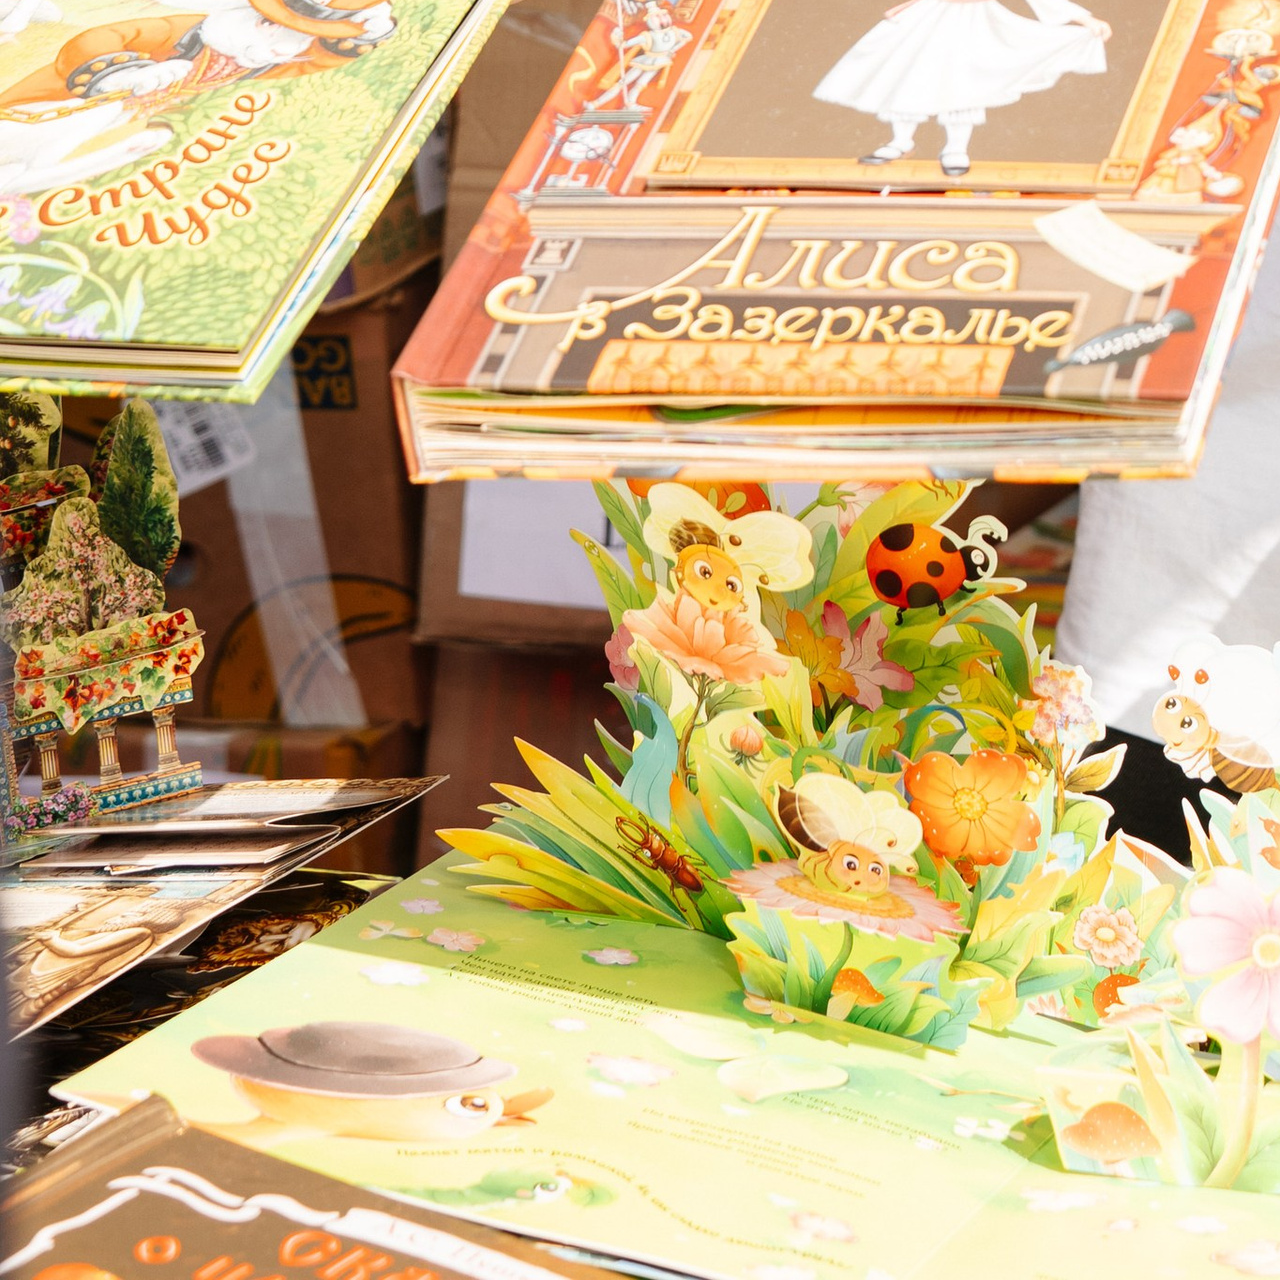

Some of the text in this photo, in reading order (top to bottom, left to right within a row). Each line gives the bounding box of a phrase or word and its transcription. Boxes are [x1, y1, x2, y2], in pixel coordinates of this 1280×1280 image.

[38, 92, 272, 227] Стране
[610, 205, 1021, 305] Алиса
[622, 286, 1076, 352] Зазеркалье
